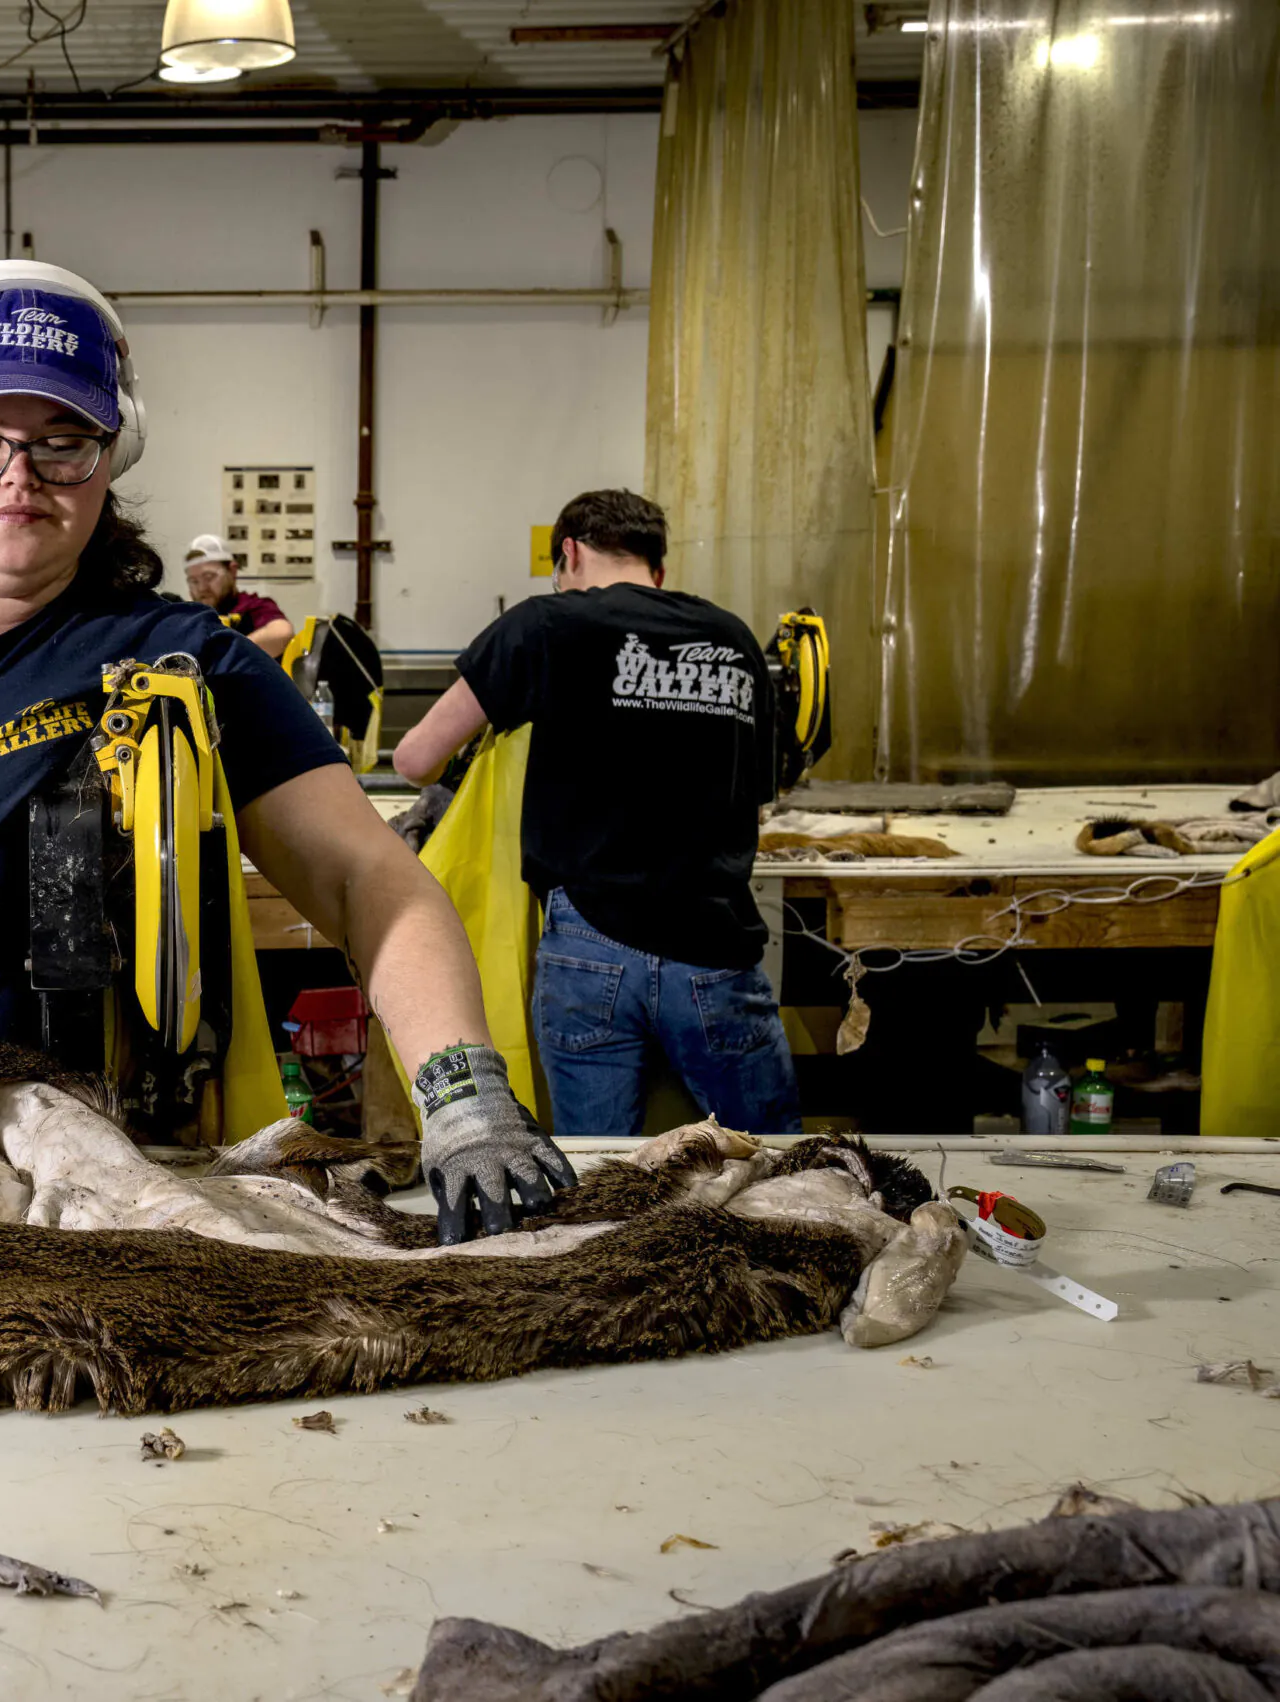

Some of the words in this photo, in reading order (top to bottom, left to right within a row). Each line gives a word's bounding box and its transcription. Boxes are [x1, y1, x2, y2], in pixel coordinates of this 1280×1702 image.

[11, 307, 68, 324] Team
[669, 642, 744, 662] Team
[615, 654, 755, 687] WILDLIFE
[612, 674, 753, 711] GALLERY
